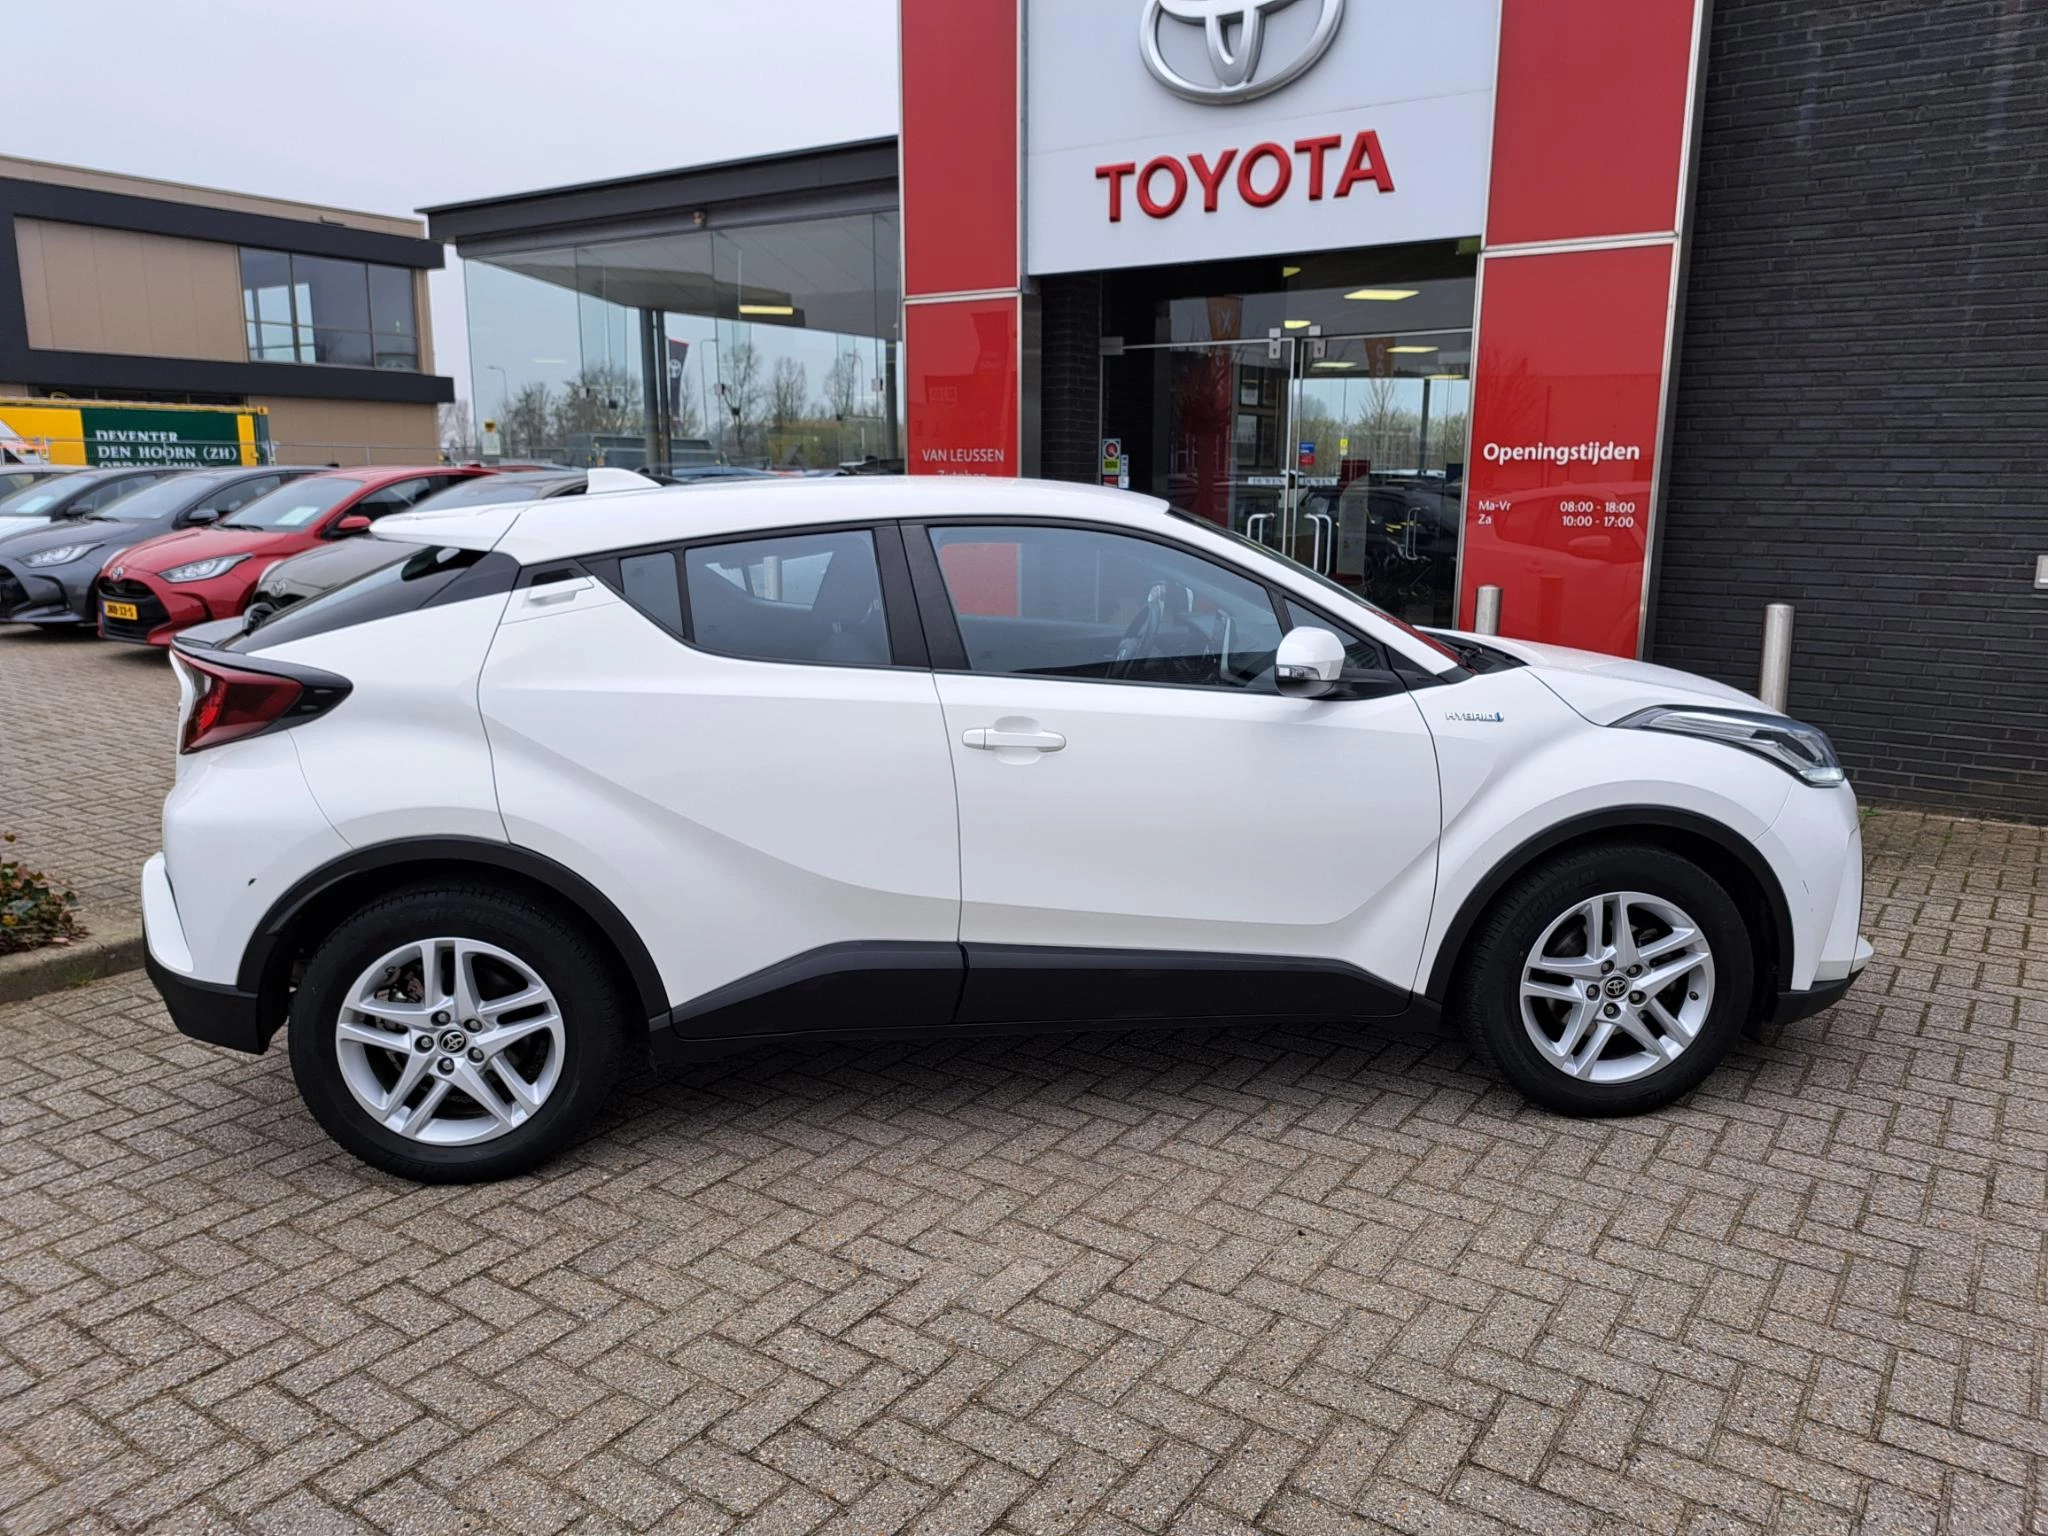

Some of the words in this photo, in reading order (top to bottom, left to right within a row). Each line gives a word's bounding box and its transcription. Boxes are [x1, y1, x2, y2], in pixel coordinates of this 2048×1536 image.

[1095, 129, 1395, 222] TOYOTA
[95, 430, 178, 442] DEVENTER
[97, 445, 131, 459] DEN
[138, 446, 196, 459] HOORN
[203, 446, 237, 461] (ZH)
[921, 448, 947, 462] VAN
[950, 448, 1005, 462] LEUSSEN
[1483, 441, 1640, 466] Openingstijden
[1478, 500, 1512, 512] Ma-Vr
[1559, 501, 1594, 513] 08:00
[1605, 502, 1635, 513] 18:00
[1478, 514, 1492, 525] Za
[1562, 515, 1592, 527] 10:00
[1603, 516, 1634, 528] 17:00
[1445, 712, 1495, 721] HYBRID
